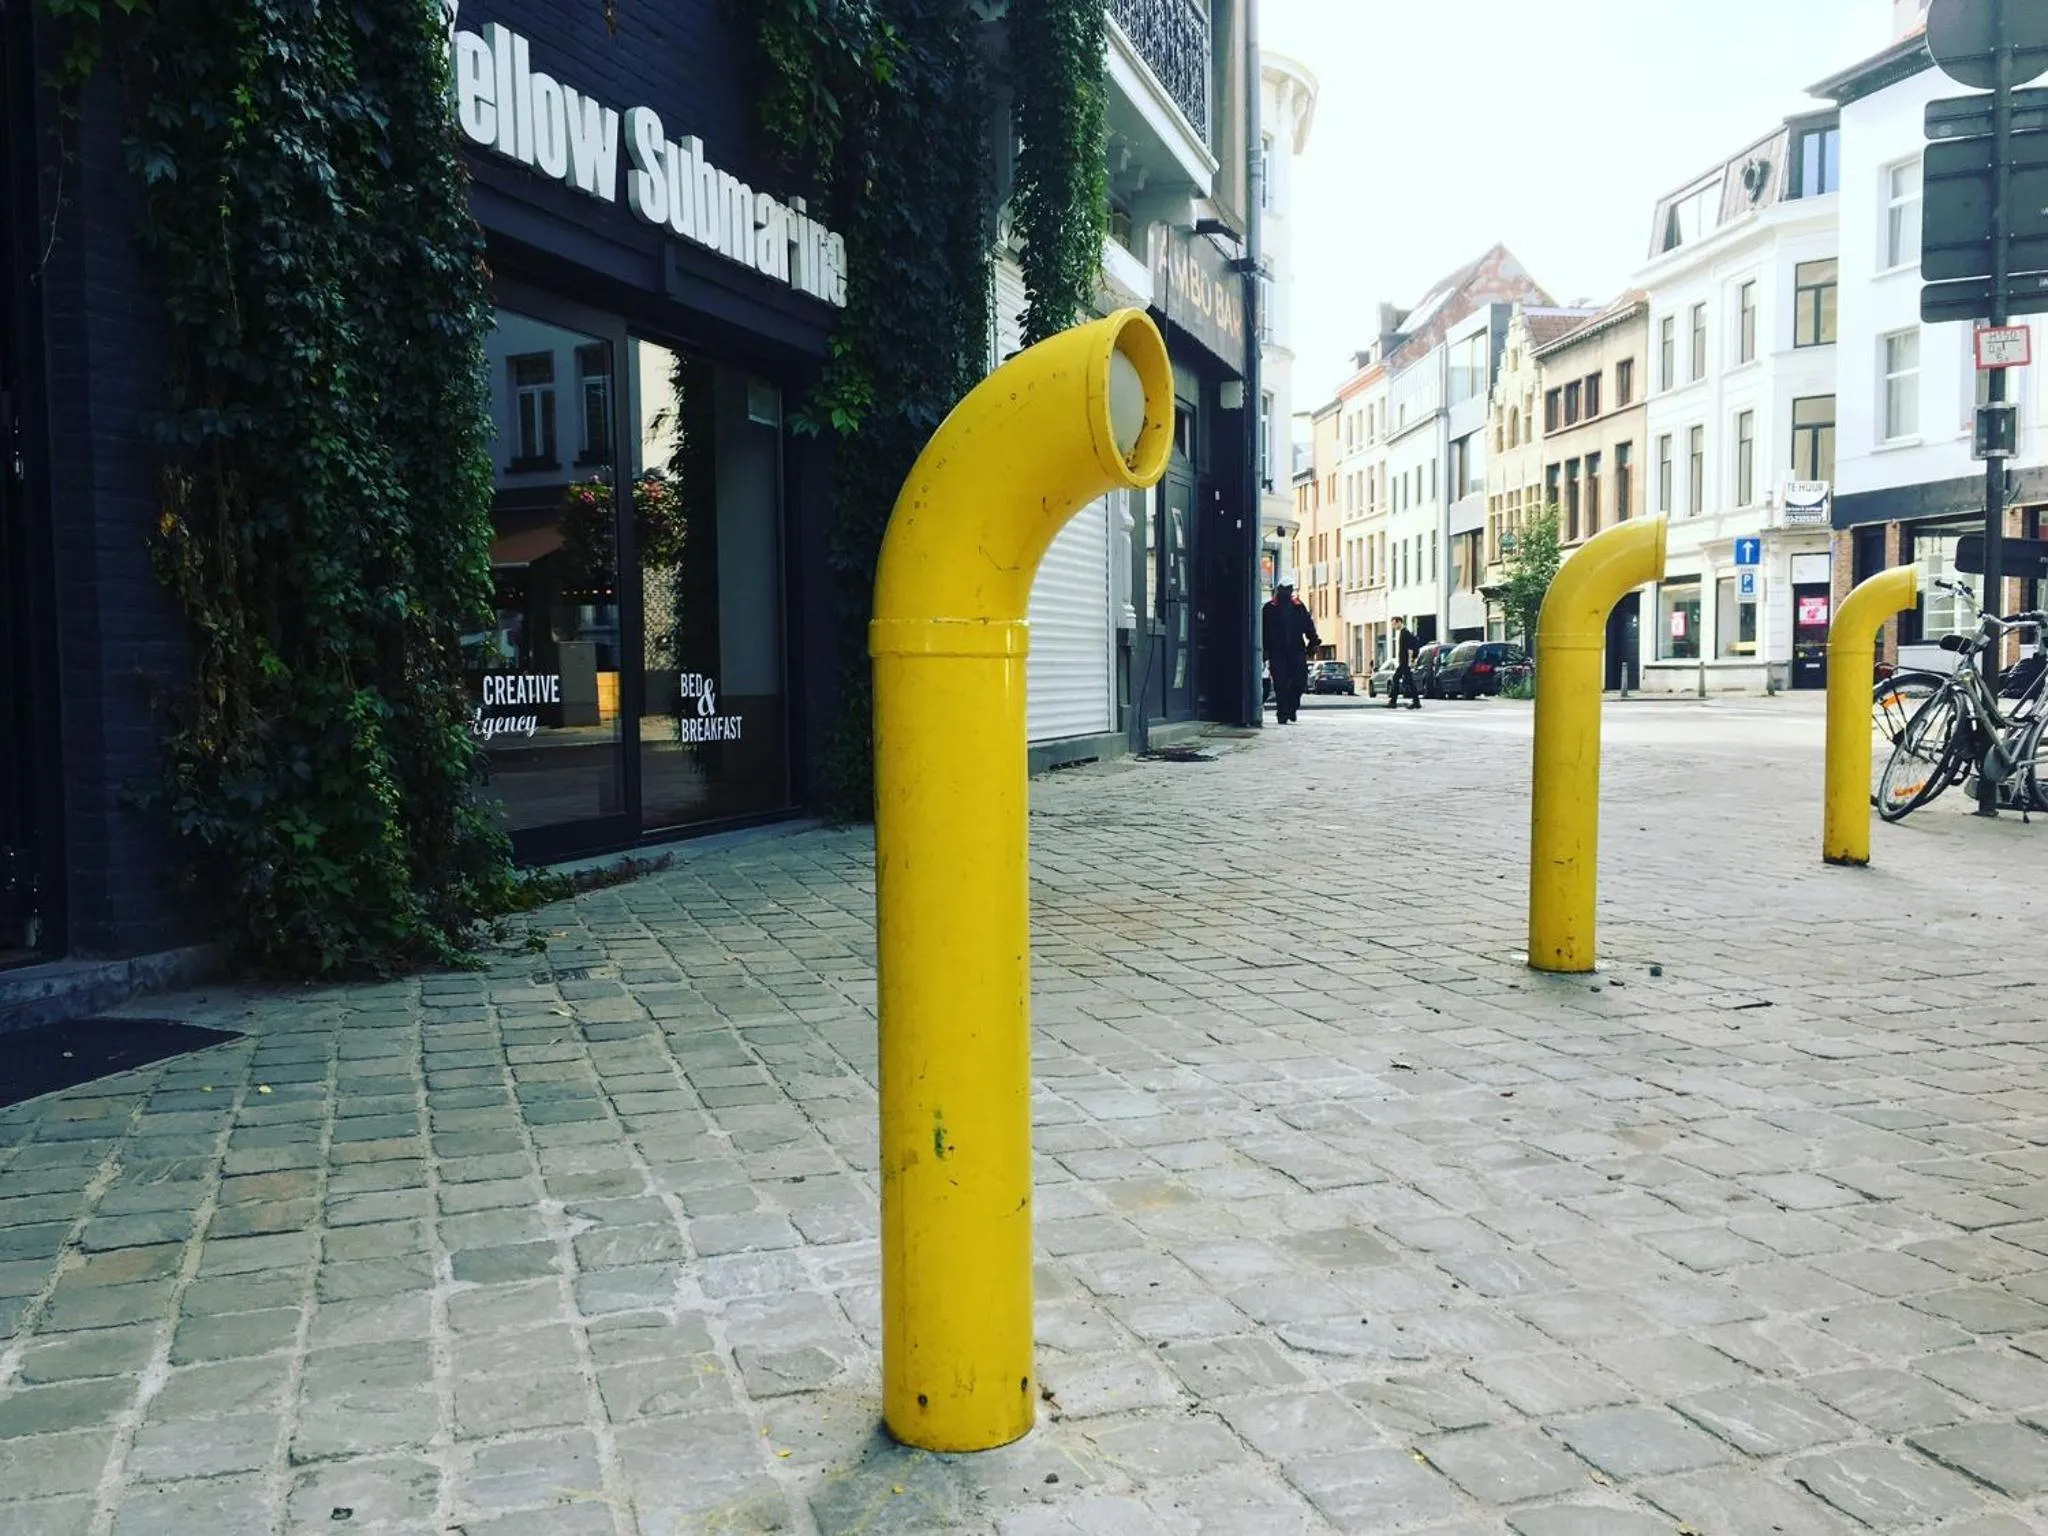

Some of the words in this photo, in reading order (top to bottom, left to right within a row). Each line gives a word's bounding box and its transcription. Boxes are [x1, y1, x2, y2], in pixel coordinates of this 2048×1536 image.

[624, 105, 848, 309] Submarine
[482, 675, 561, 705] CREATIVE
[680, 673, 703, 697] BED
[697, 678, 716, 717] &
[681, 716, 743, 743] BREAKFAST
